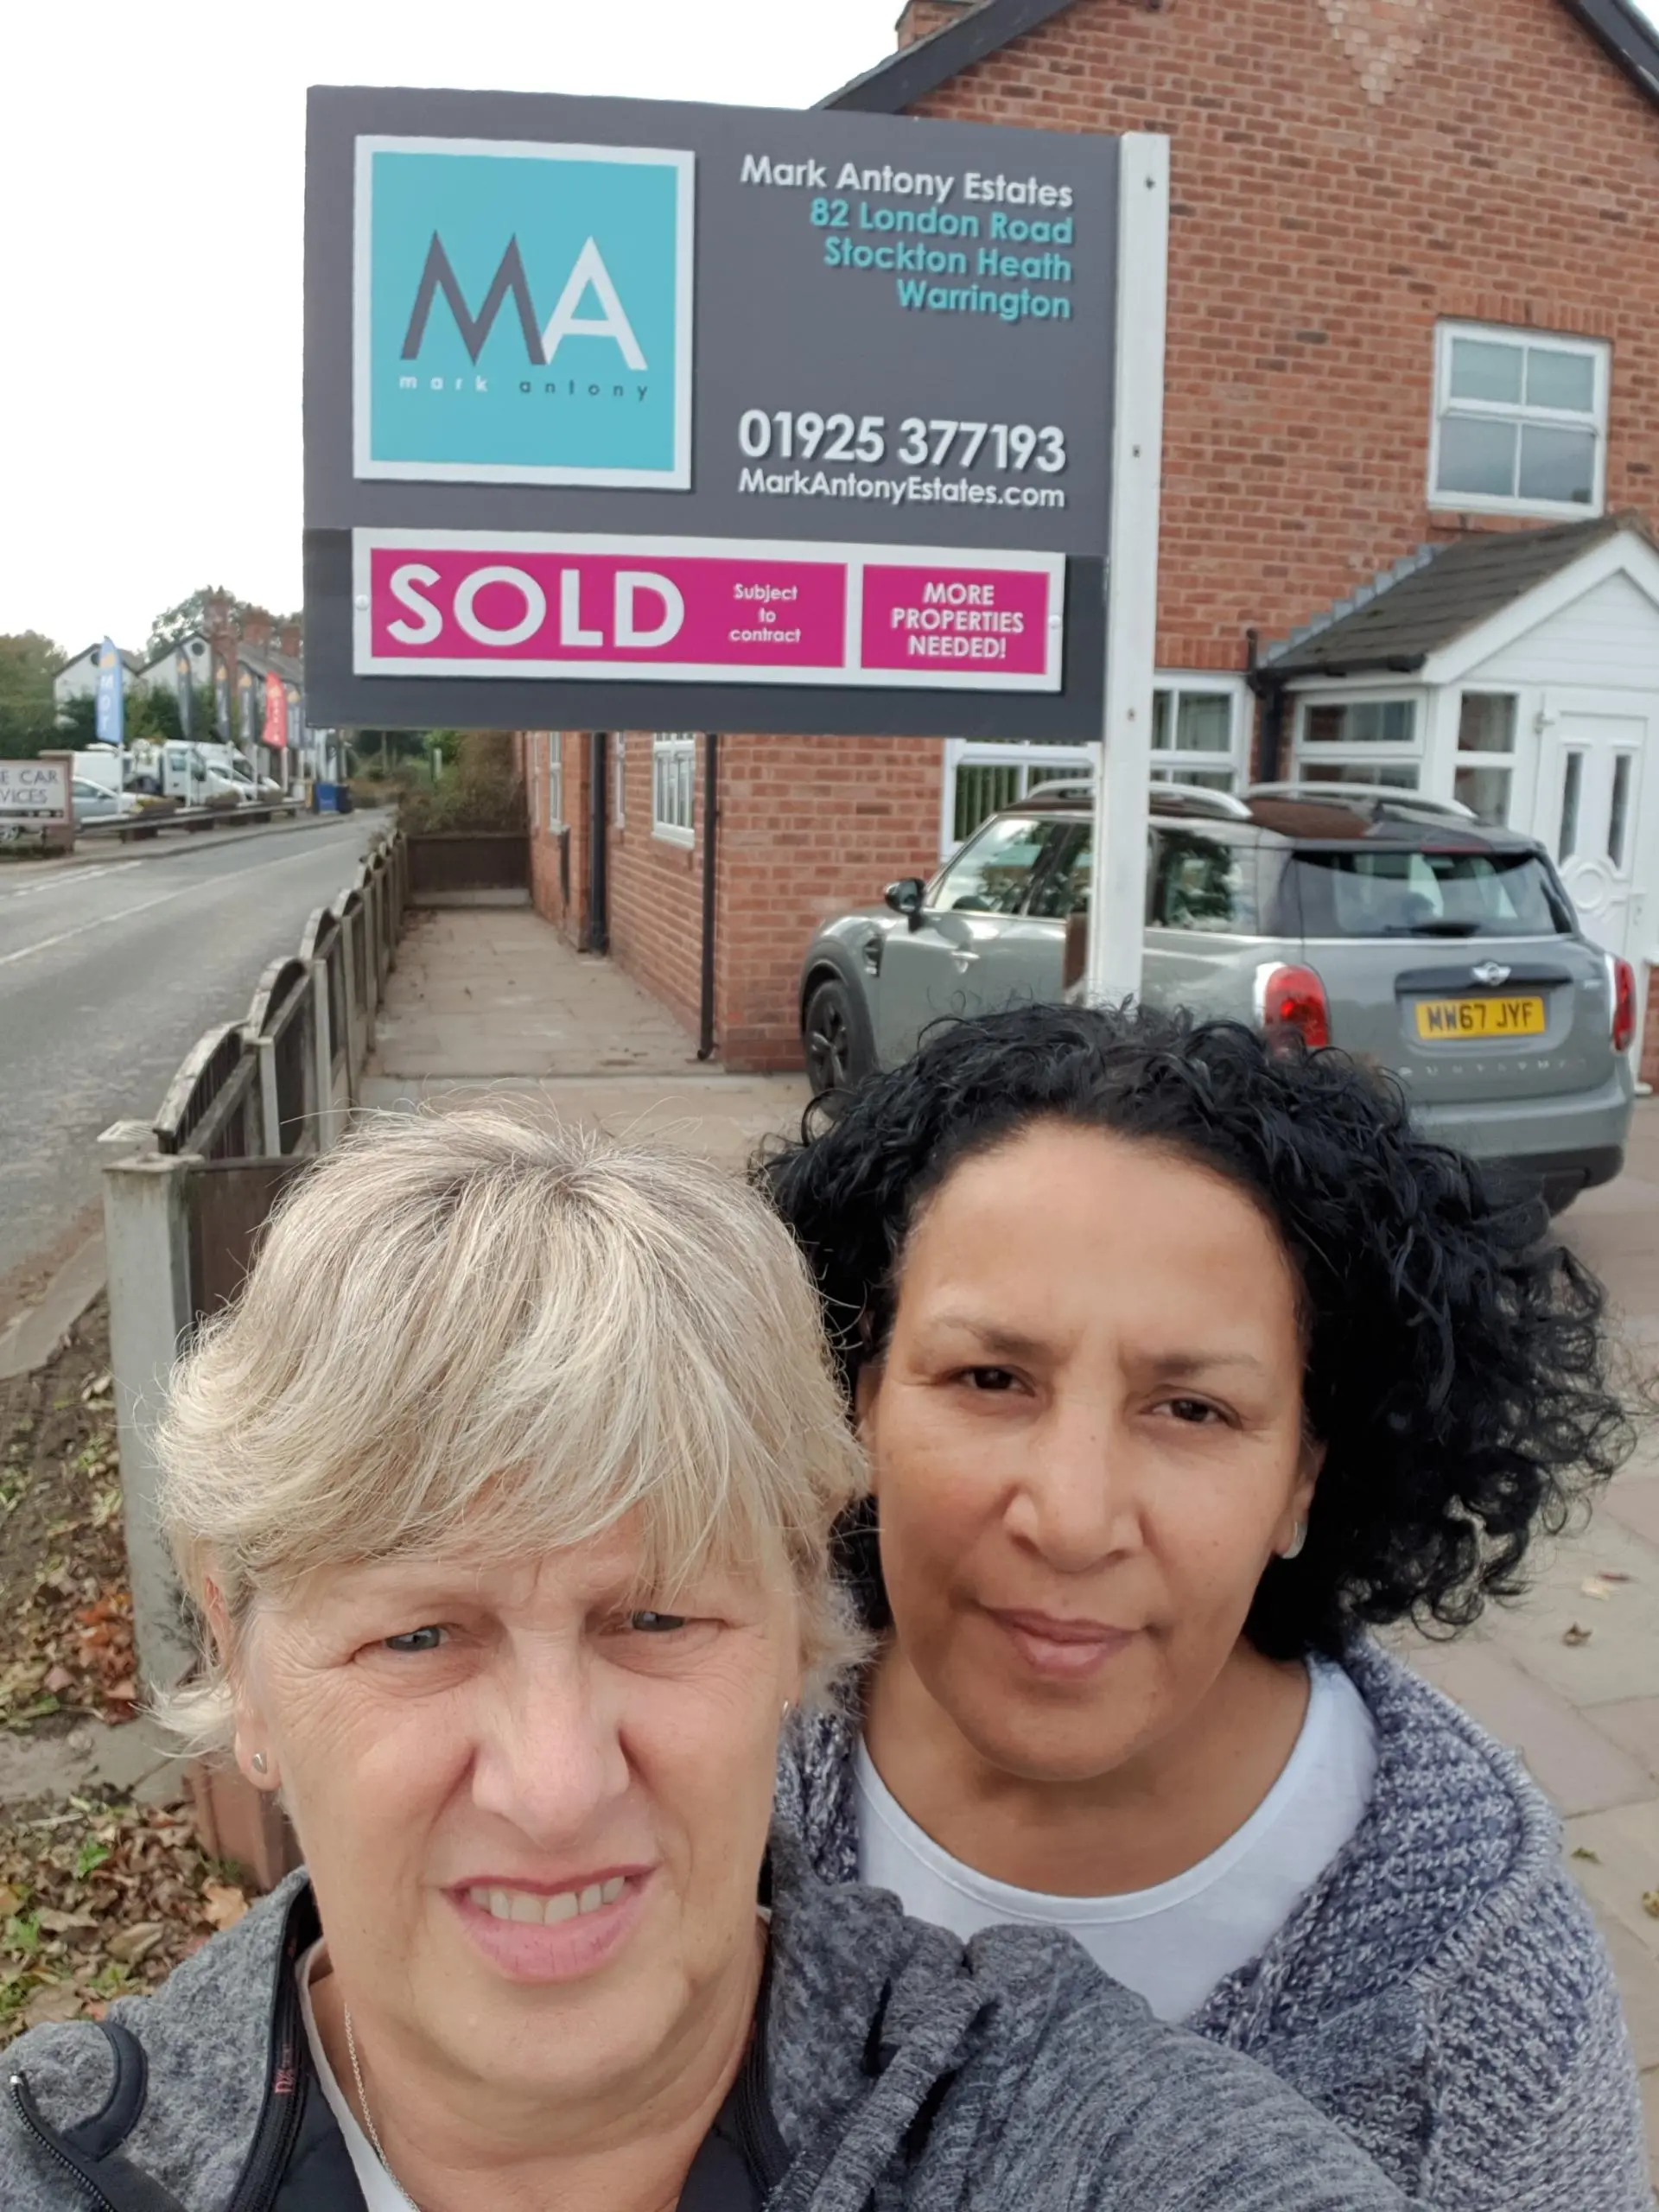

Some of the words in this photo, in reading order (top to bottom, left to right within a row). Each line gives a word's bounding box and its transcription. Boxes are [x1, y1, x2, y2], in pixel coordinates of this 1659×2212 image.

[740, 154, 827, 188] Mark
[836, 162, 953, 202] Antony
[963, 172, 1074, 207] Estates
[810, 197, 849, 228] 82
[860, 201, 979, 238] London
[990, 212, 1073, 244] Road
[824, 237, 968, 274] Stockton
[978, 248, 1071, 282] Heath
[399, 230, 648, 372] MA
[897, 279, 1071, 321] Warrington
[399, 375, 488, 393] mark
[518, 379, 649, 403] antony
[739, 409, 886, 464] 01925
[897, 416, 1066, 473] 377193
[738, 467, 1065, 508] MarkAntonyEstates.com
[386, 563, 687, 650] SOLD
[733, 582, 798, 606] Subject
[922, 582, 995, 607] MORE
[759, 608, 777, 625] to
[891, 608, 1026, 634] PROPERTIES
[728, 626, 802, 645] contract
[907, 634, 1009, 660] NEEDED!
[19, 769, 58, 785] CAR
[1497, 1001, 1534, 1028] JYF
